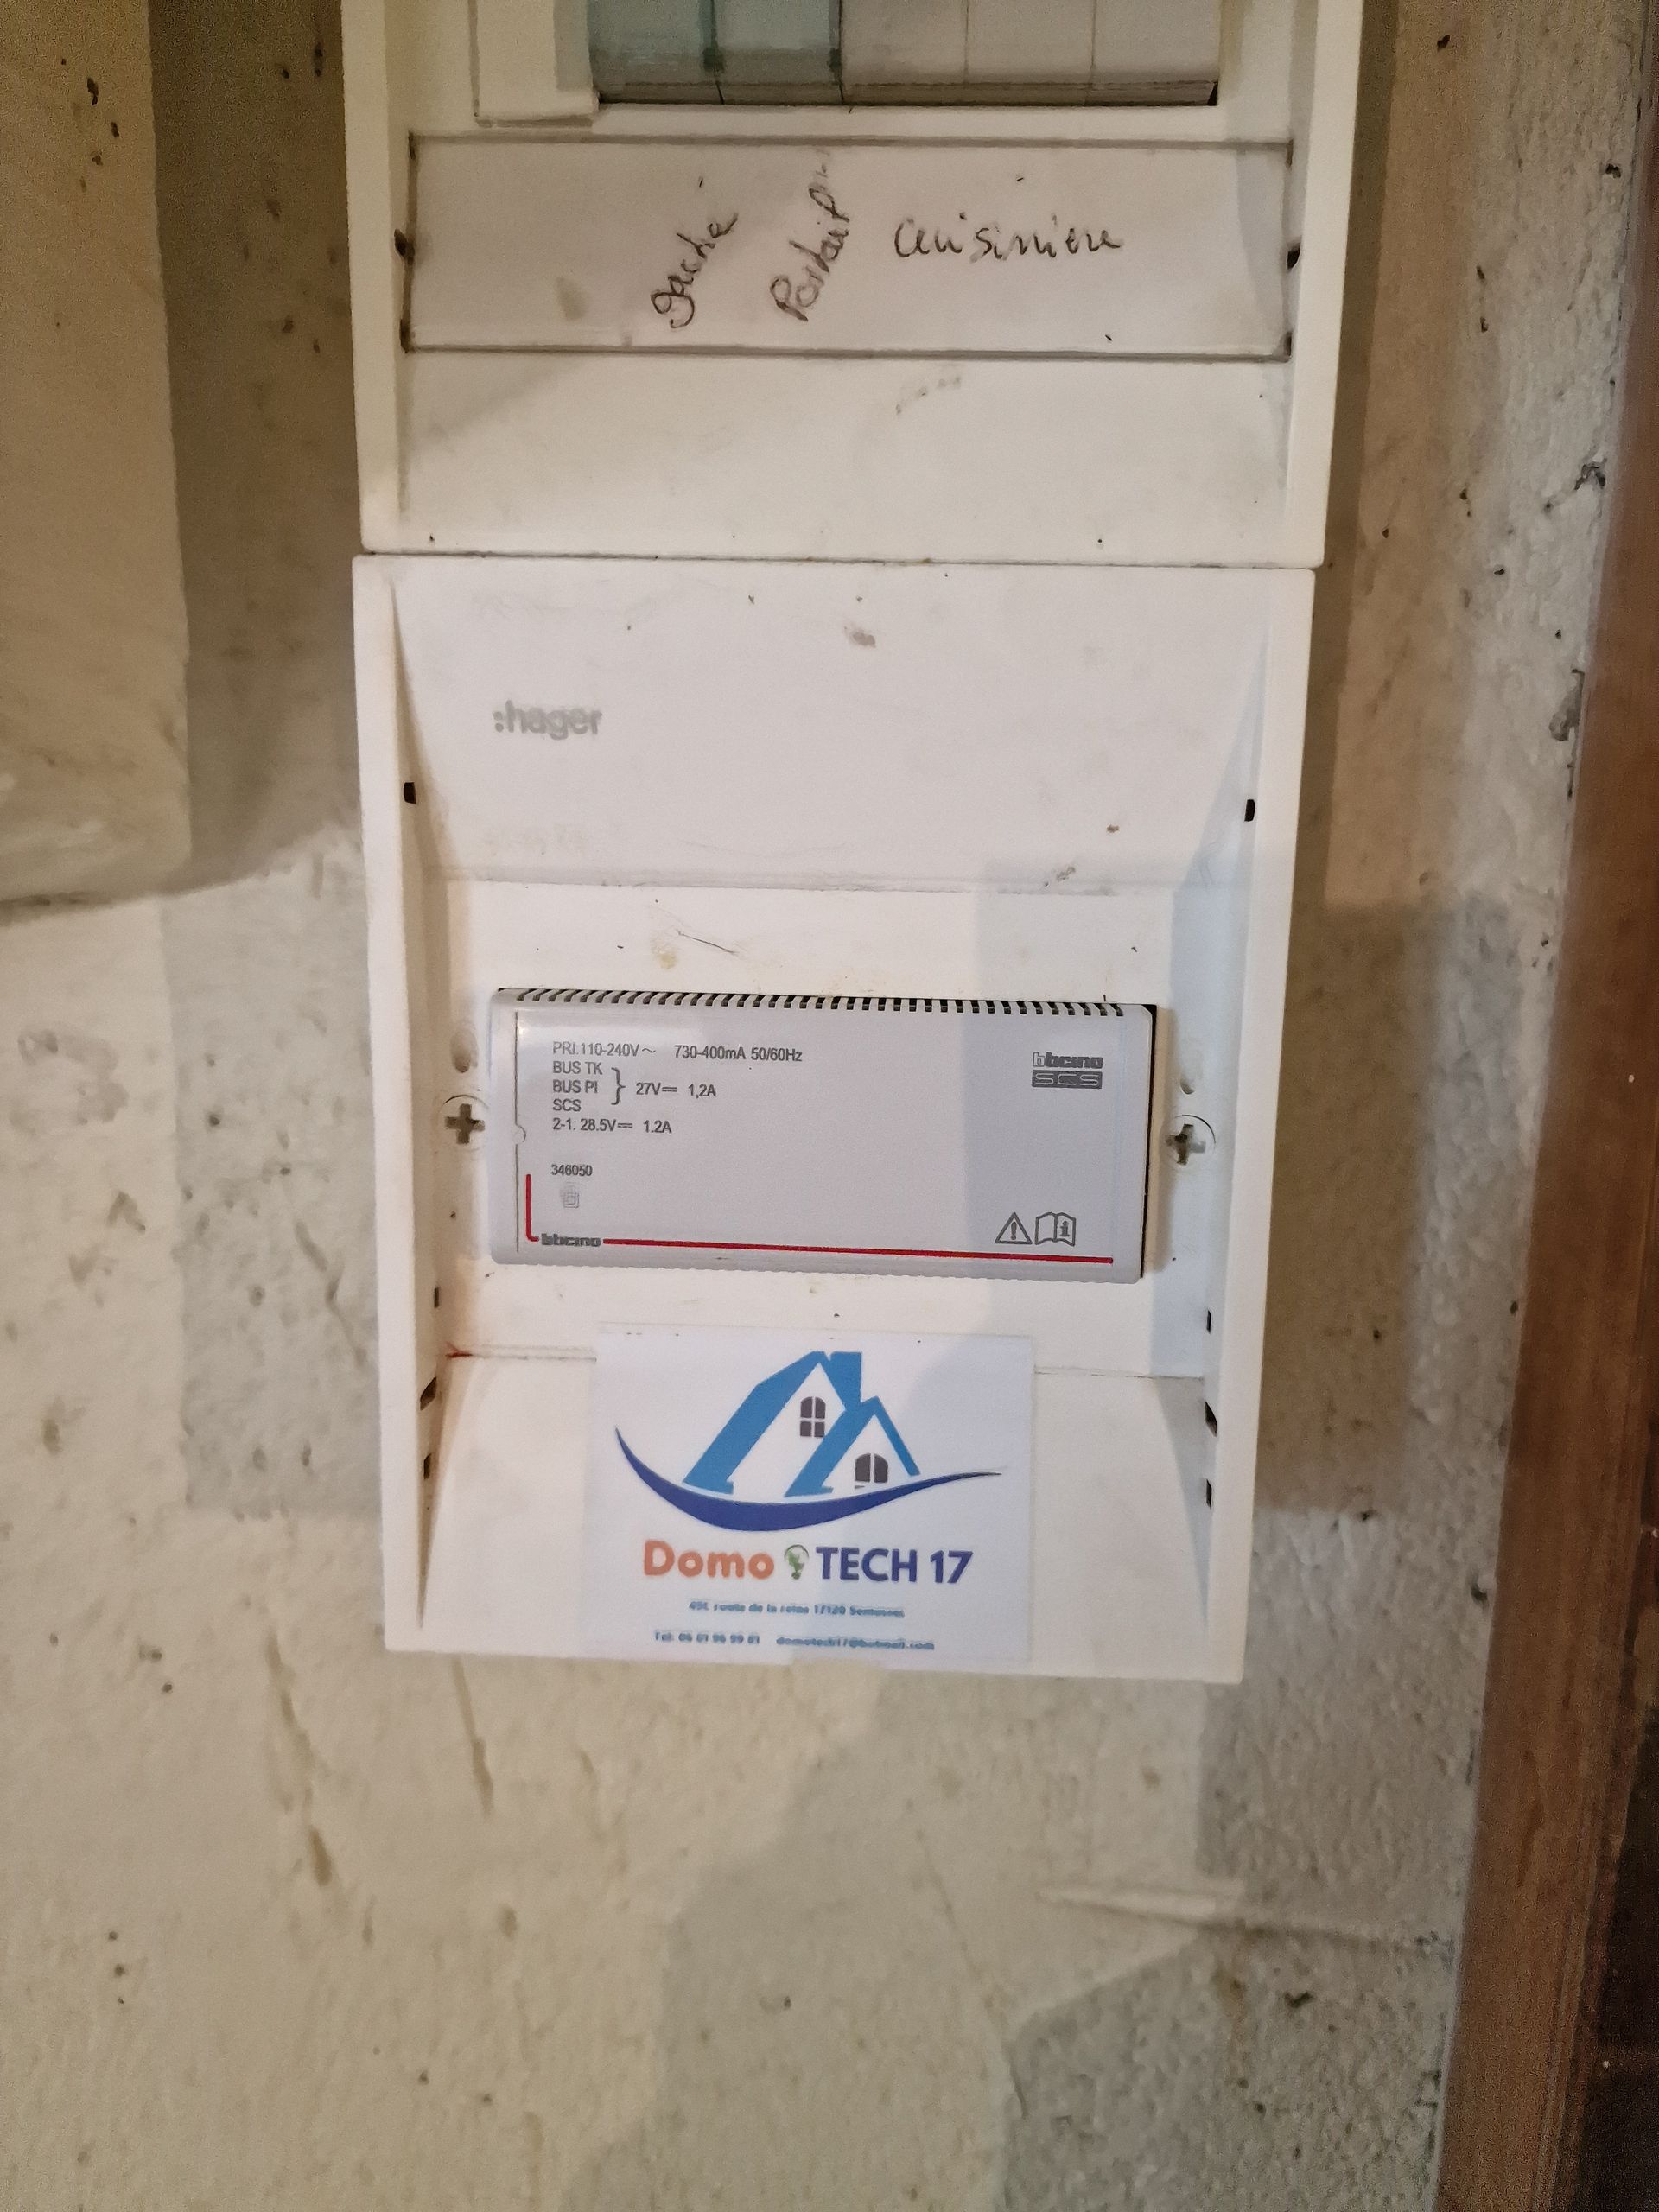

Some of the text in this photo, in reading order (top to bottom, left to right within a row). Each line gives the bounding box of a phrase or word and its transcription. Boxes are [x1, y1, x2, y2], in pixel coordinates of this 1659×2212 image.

[674, 1045, 746, 1060] 730-400mA
[751, 1046, 803, 1062] 50/60Hz
[552, 1060, 603, 1075] BUS TK
[552, 1079, 598, 1094] BUS PI
[1033, 1071, 1101, 1087] SCS
[688, 1083, 716, 1098] 1,2A
[552, 1098, 582, 1112] SCS
[643, 1120, 672, 1134] 1.2A
[550, 1164, 593, 1177] 346050
[643, 1539, 974, 1585] Domo TECH 17
